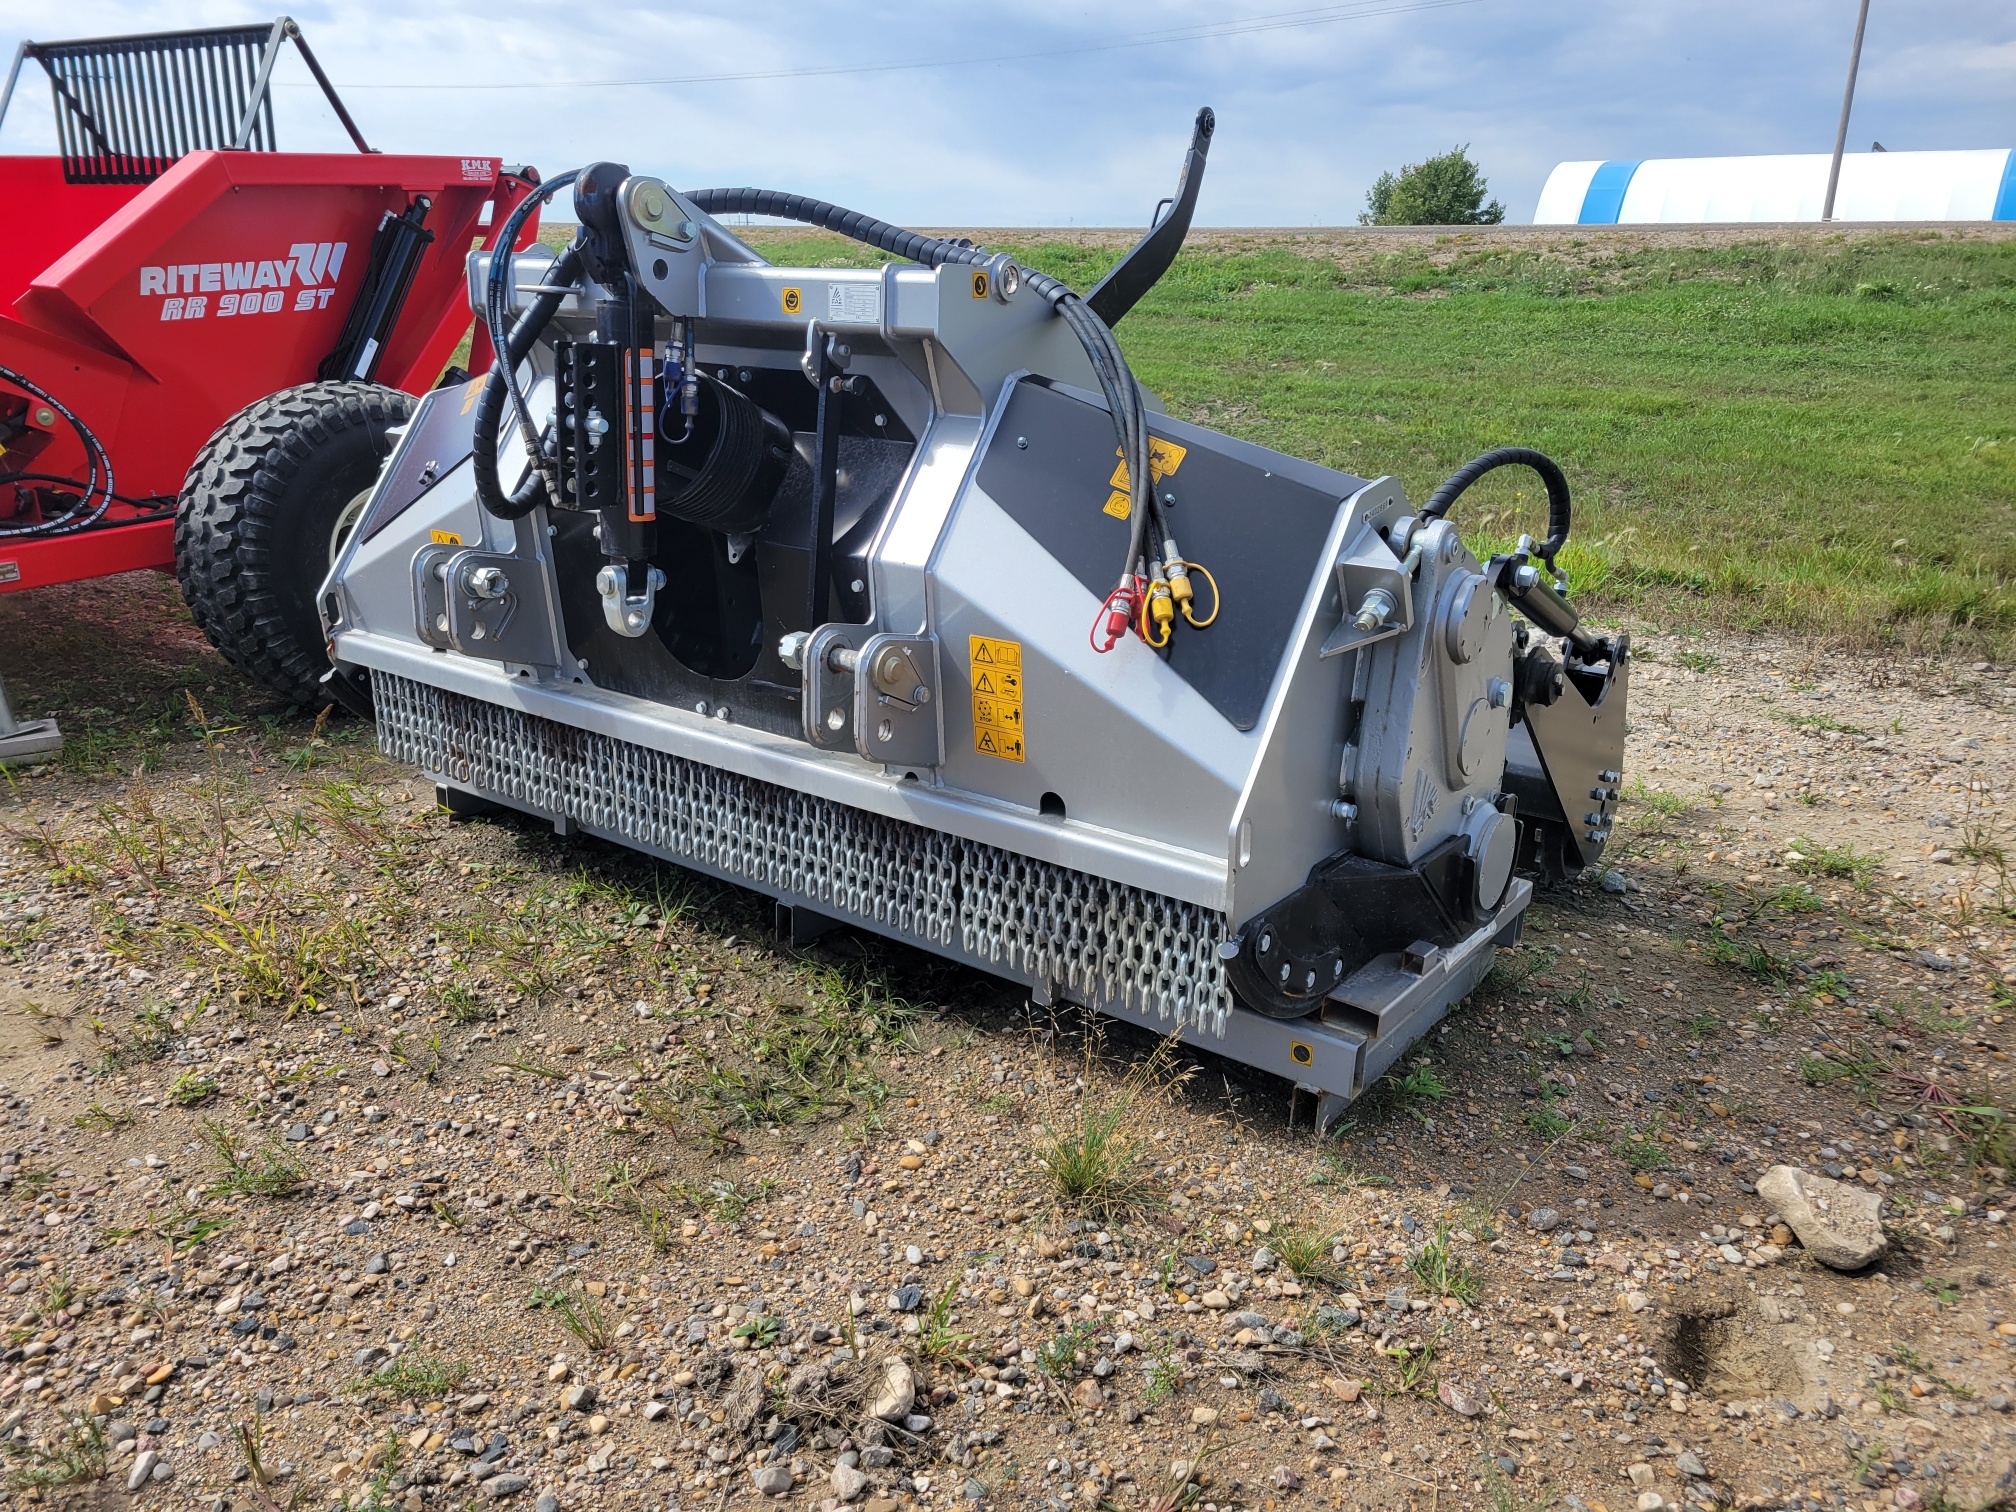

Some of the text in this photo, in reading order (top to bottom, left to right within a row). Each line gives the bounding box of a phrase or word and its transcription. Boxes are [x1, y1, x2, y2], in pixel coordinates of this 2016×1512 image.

[461, 160, 491, 170] KMK
[139, 260, 297, 296] RITEWAY
[160, 288, 336, 322] RR 900 ST
